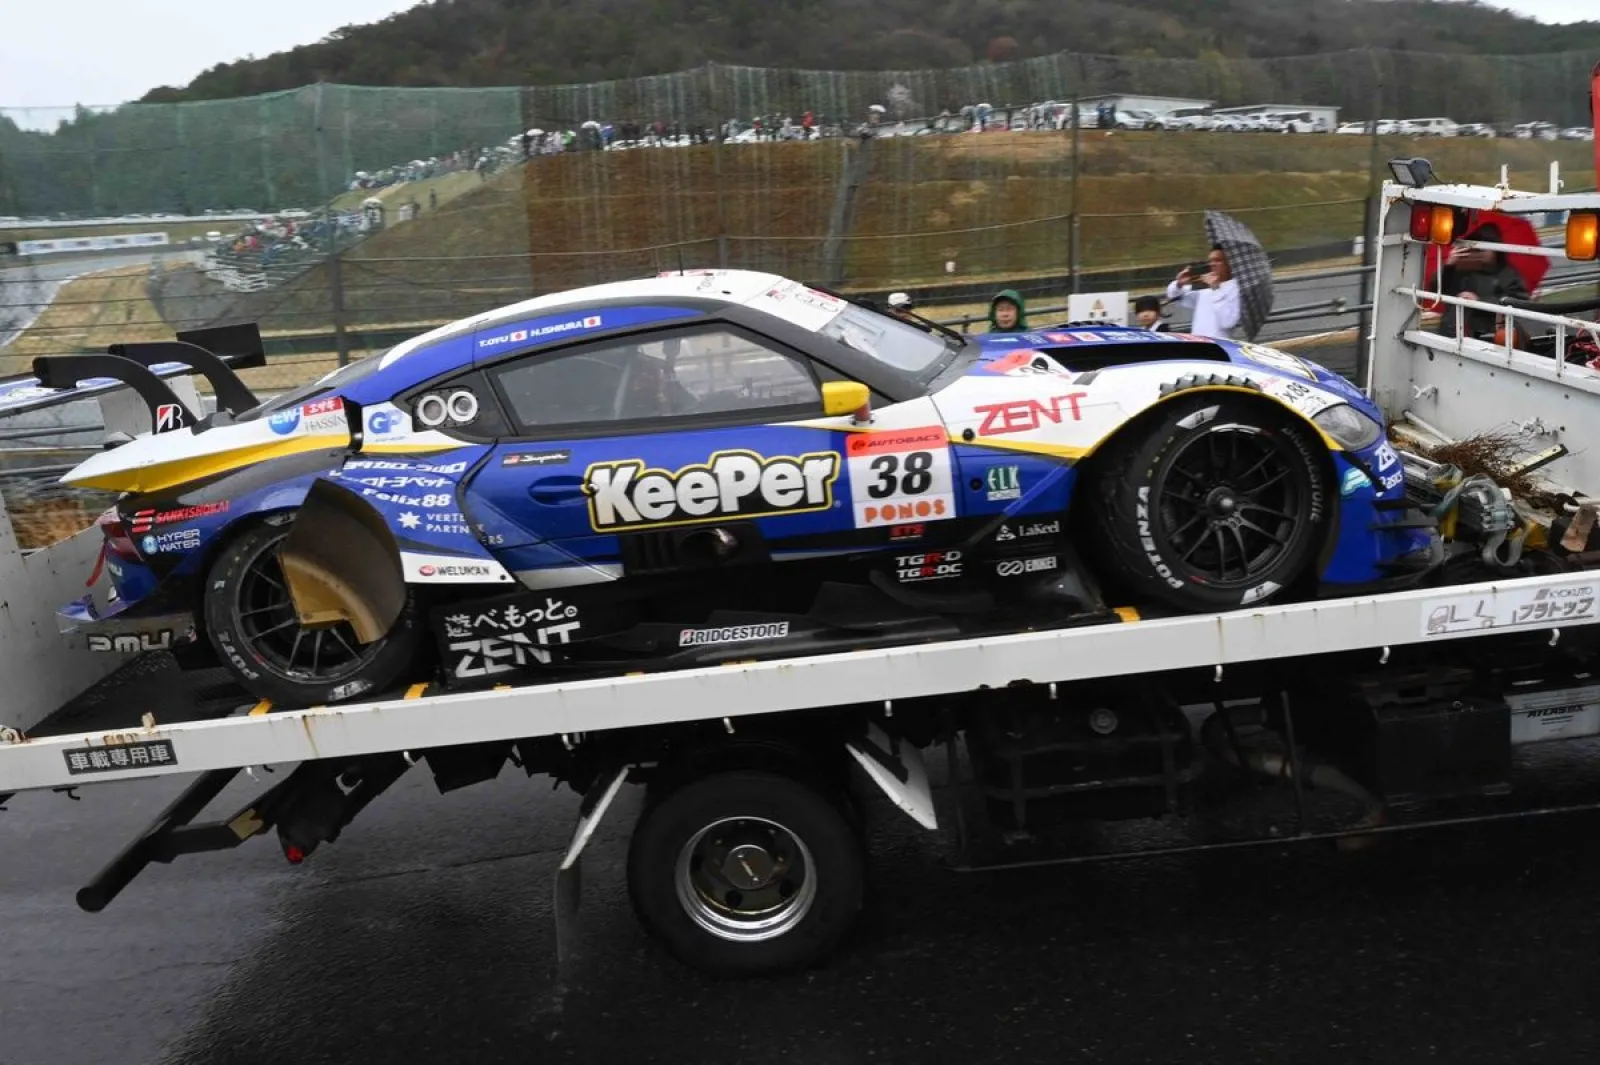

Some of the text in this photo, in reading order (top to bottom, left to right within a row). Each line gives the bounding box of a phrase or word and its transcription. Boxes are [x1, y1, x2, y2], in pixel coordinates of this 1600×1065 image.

[973, 392, 1088, 437] ZENT
[868, 434, 941, 448] AUTOBACS
[867, 451, 933, 499] 38
[986, 464, 1020, 491] ELK
[362, 487, 452, 507] Felix88
[588, 455, 835, 525] KeePer
[864, 499, 945, 523] PONOS
[157, 528, 200, 543] HYPER
[159, 539, 200, 553] WATER
[1136, 486, 1185, 589] POTENZA
[1025, 556, 1058, 572] ENKEI
[681, 622, 789, 646] BRIDGESTONE
[449, 620, 582, 679] ZENT
